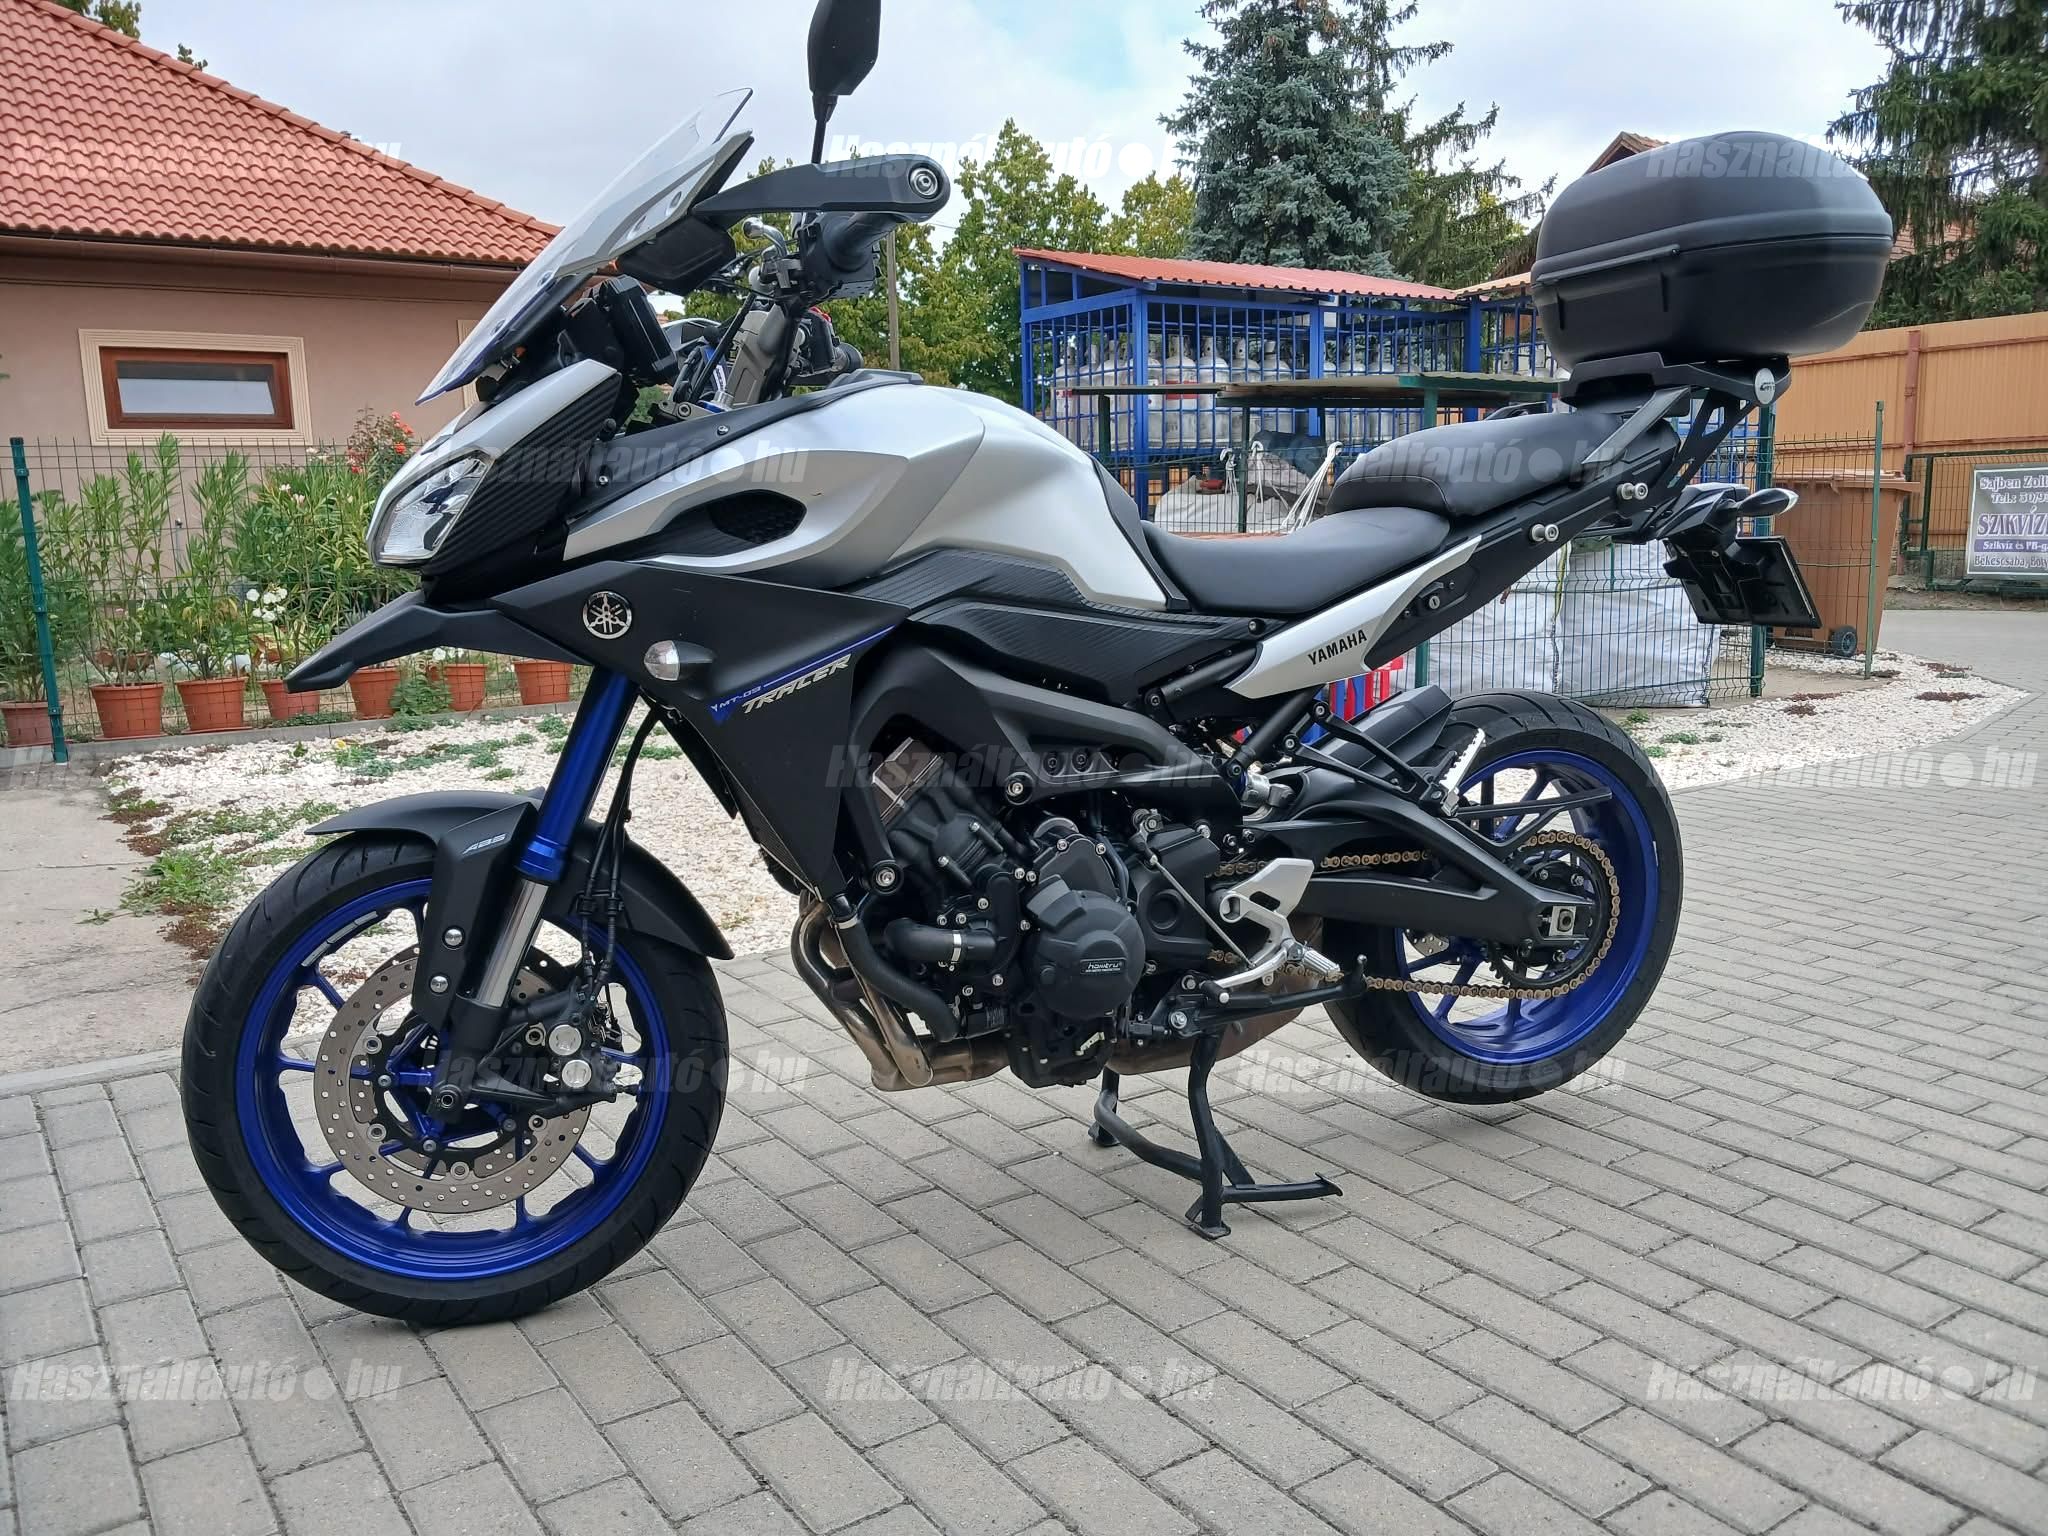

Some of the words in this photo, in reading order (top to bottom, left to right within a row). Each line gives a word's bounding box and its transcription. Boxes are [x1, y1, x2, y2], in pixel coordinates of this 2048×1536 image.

[1979, 475, 2021, 492] Sajben
[1977, 505, 2048, 536] SZIKVÍZ
[2025, 541, 2048, 552] PB-g
[1307, 629, 1368, 666] YAMAHA
[719, 685, 763, 710] MT-09
[741, 653, 852, 714] TRACER
